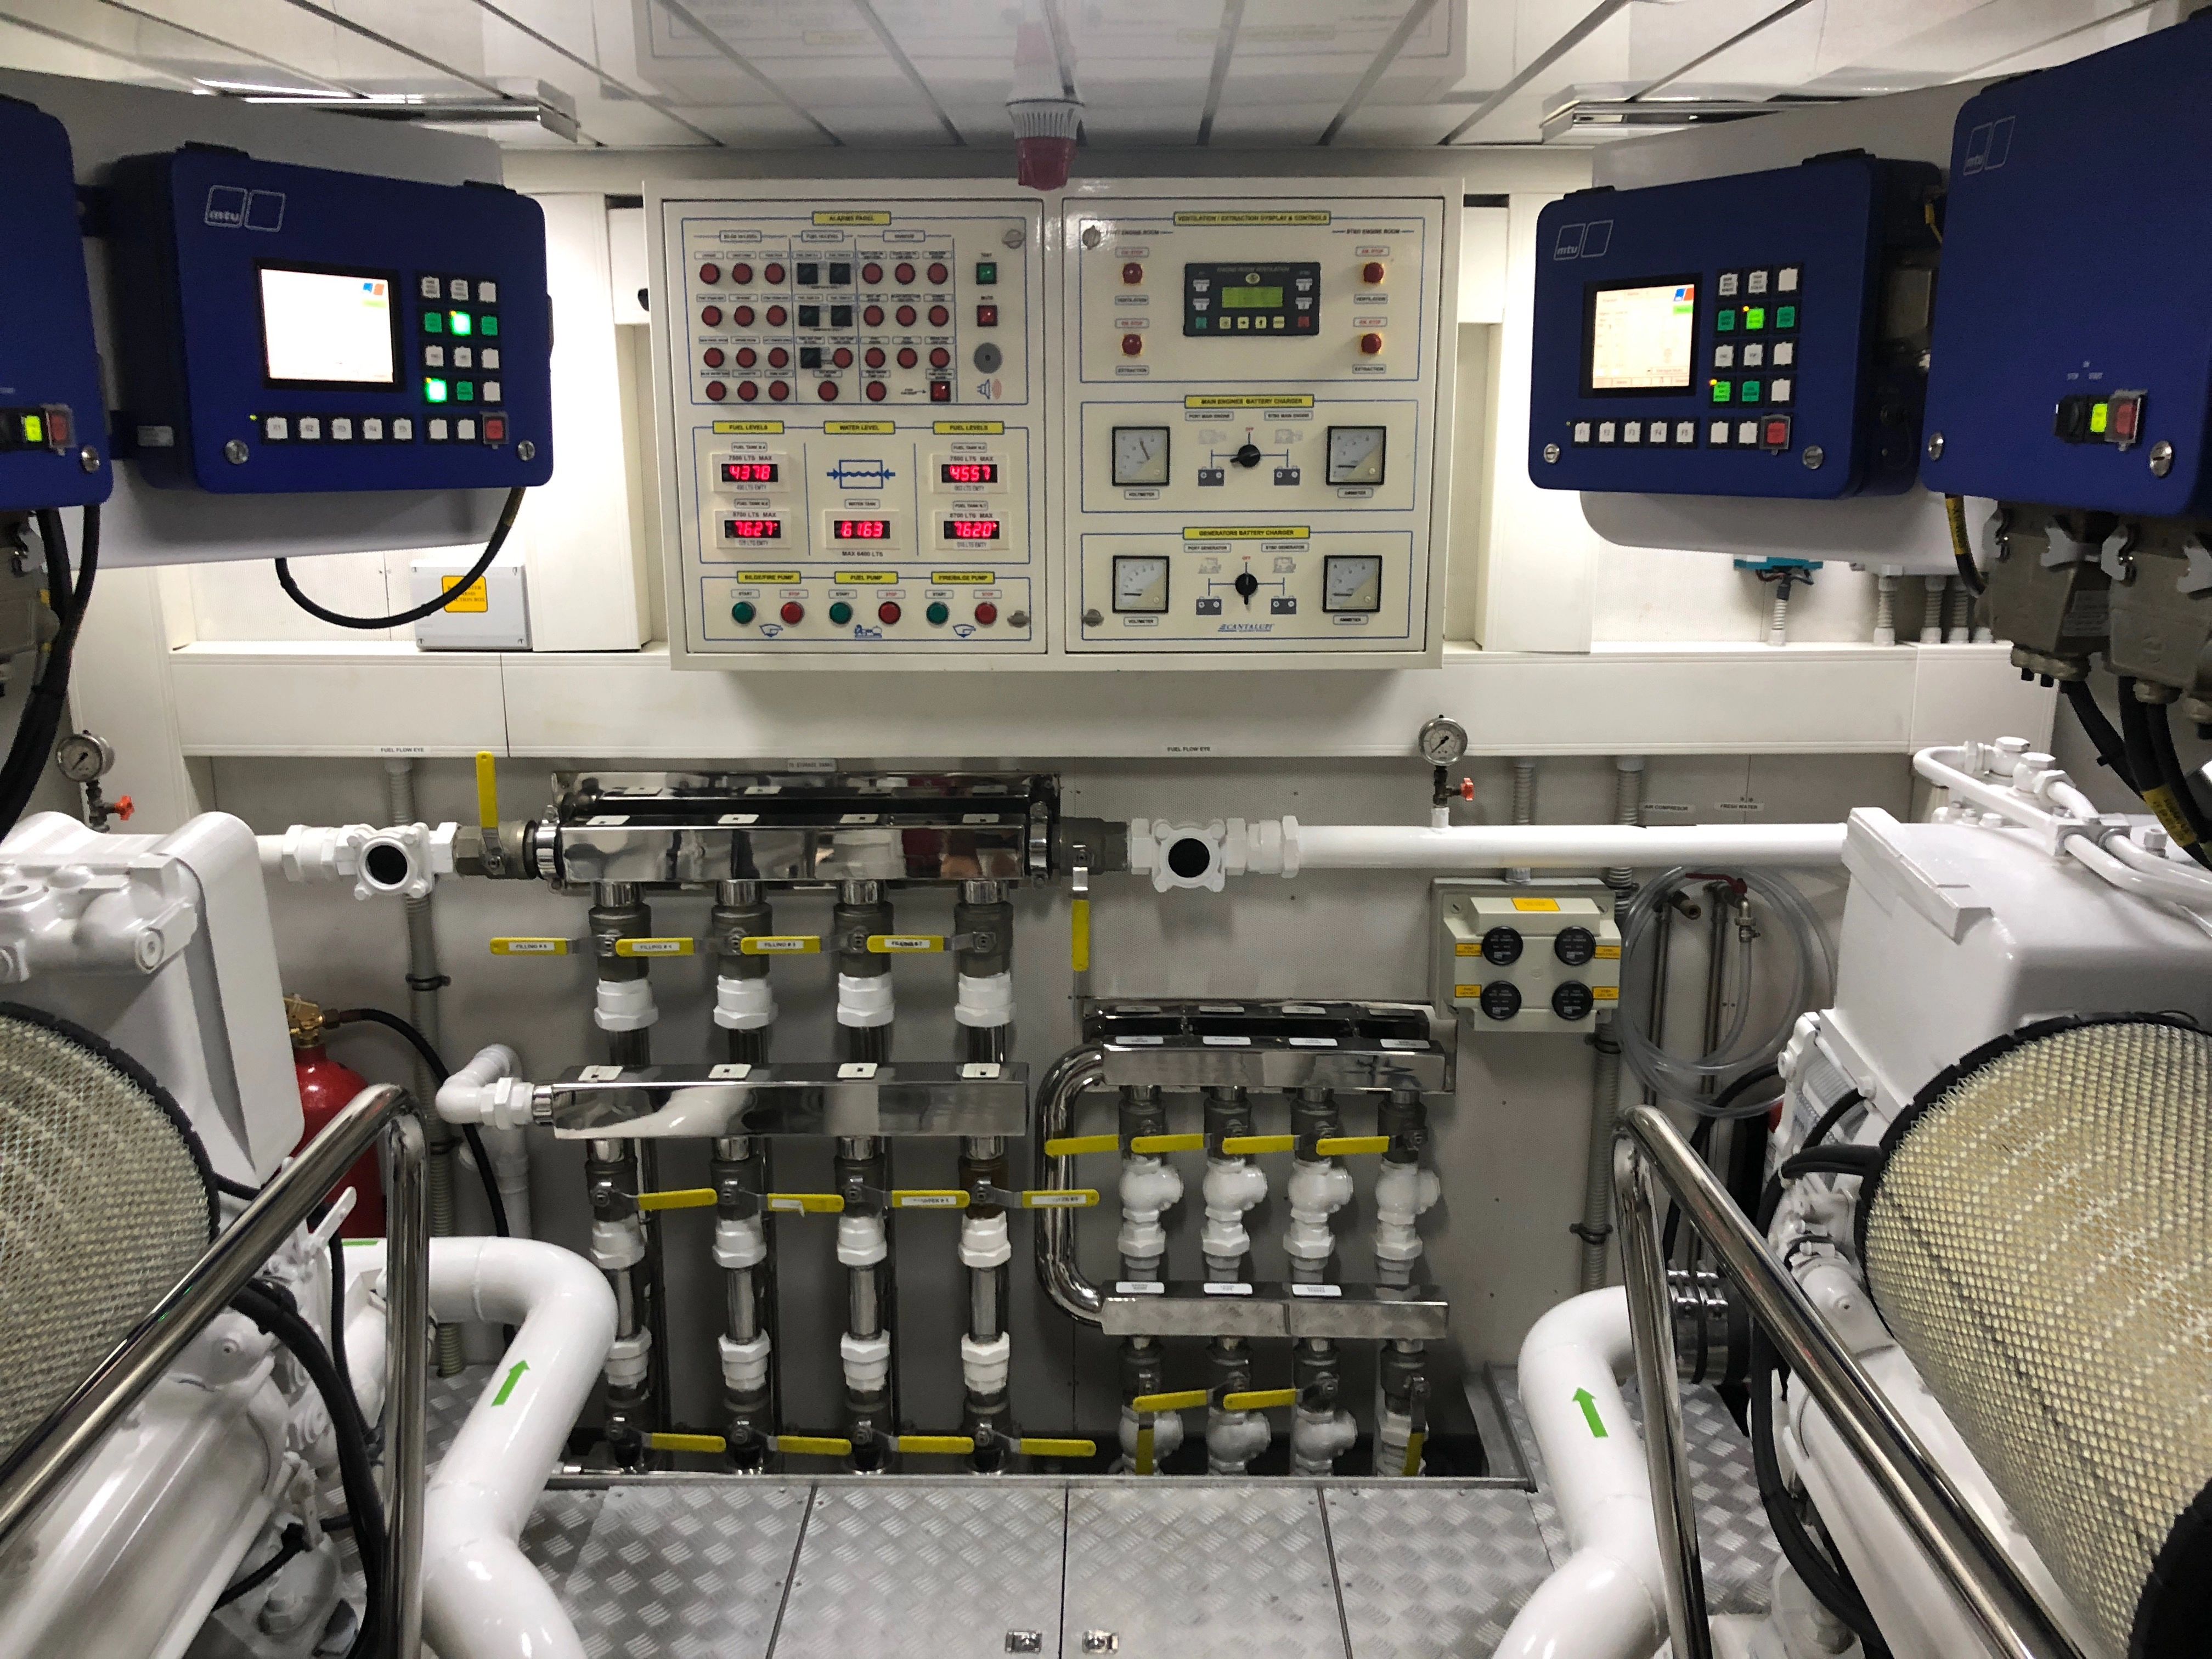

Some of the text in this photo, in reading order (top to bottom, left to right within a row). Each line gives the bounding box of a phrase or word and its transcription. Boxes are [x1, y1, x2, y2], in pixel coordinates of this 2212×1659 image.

[209, 210, 240, 222] mtu
[1557, 245, 1578, 255] mtu
[729, 465, 771, 481] 4378
[949, 465, 991, 481] 4557
[842, 522, 883, 537] 6163
